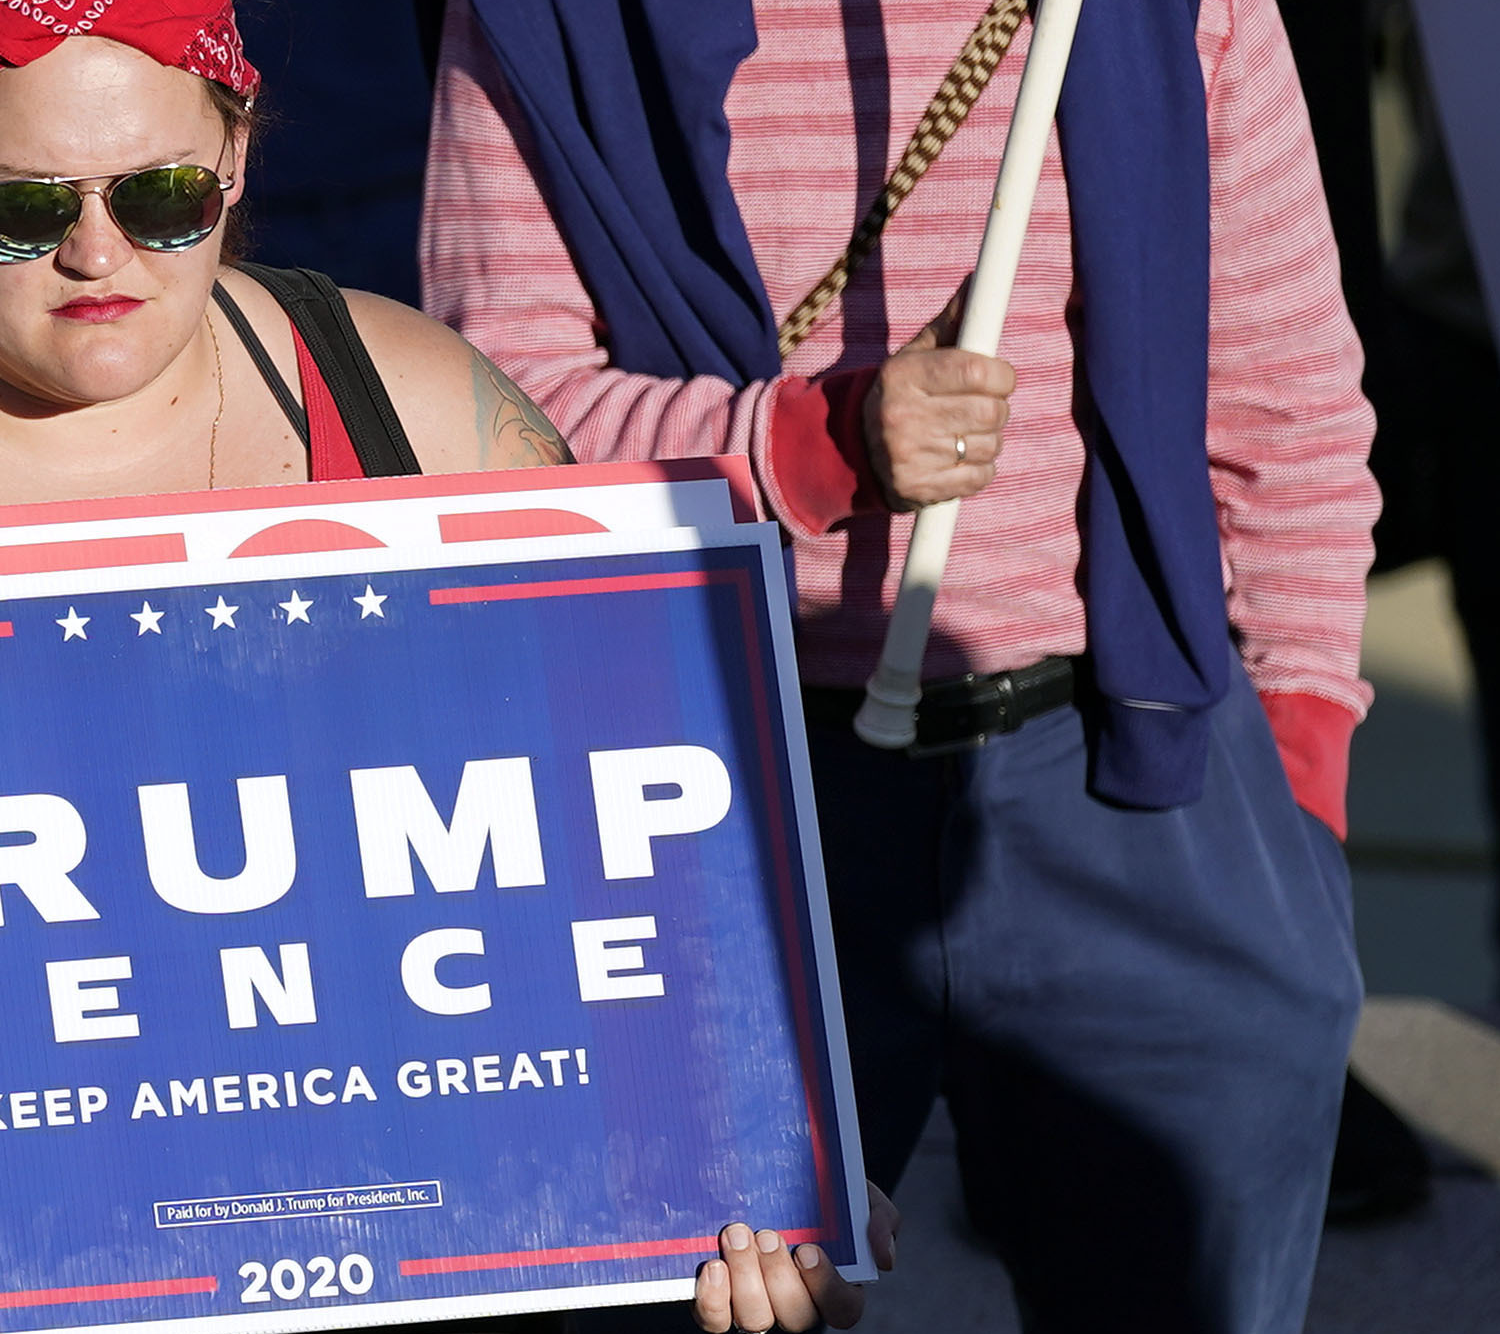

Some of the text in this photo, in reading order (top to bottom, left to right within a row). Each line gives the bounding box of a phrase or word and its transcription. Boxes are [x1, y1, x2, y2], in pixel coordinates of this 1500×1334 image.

[131, 1066, 377, 1119] AMERICA
[397, 1049, 589, 1097] GREAT!
[167, 1187, 430, 1220] Paid for by Donald J. Trump for President, Inc.
[239, 1253, 375, 1304] 2020
